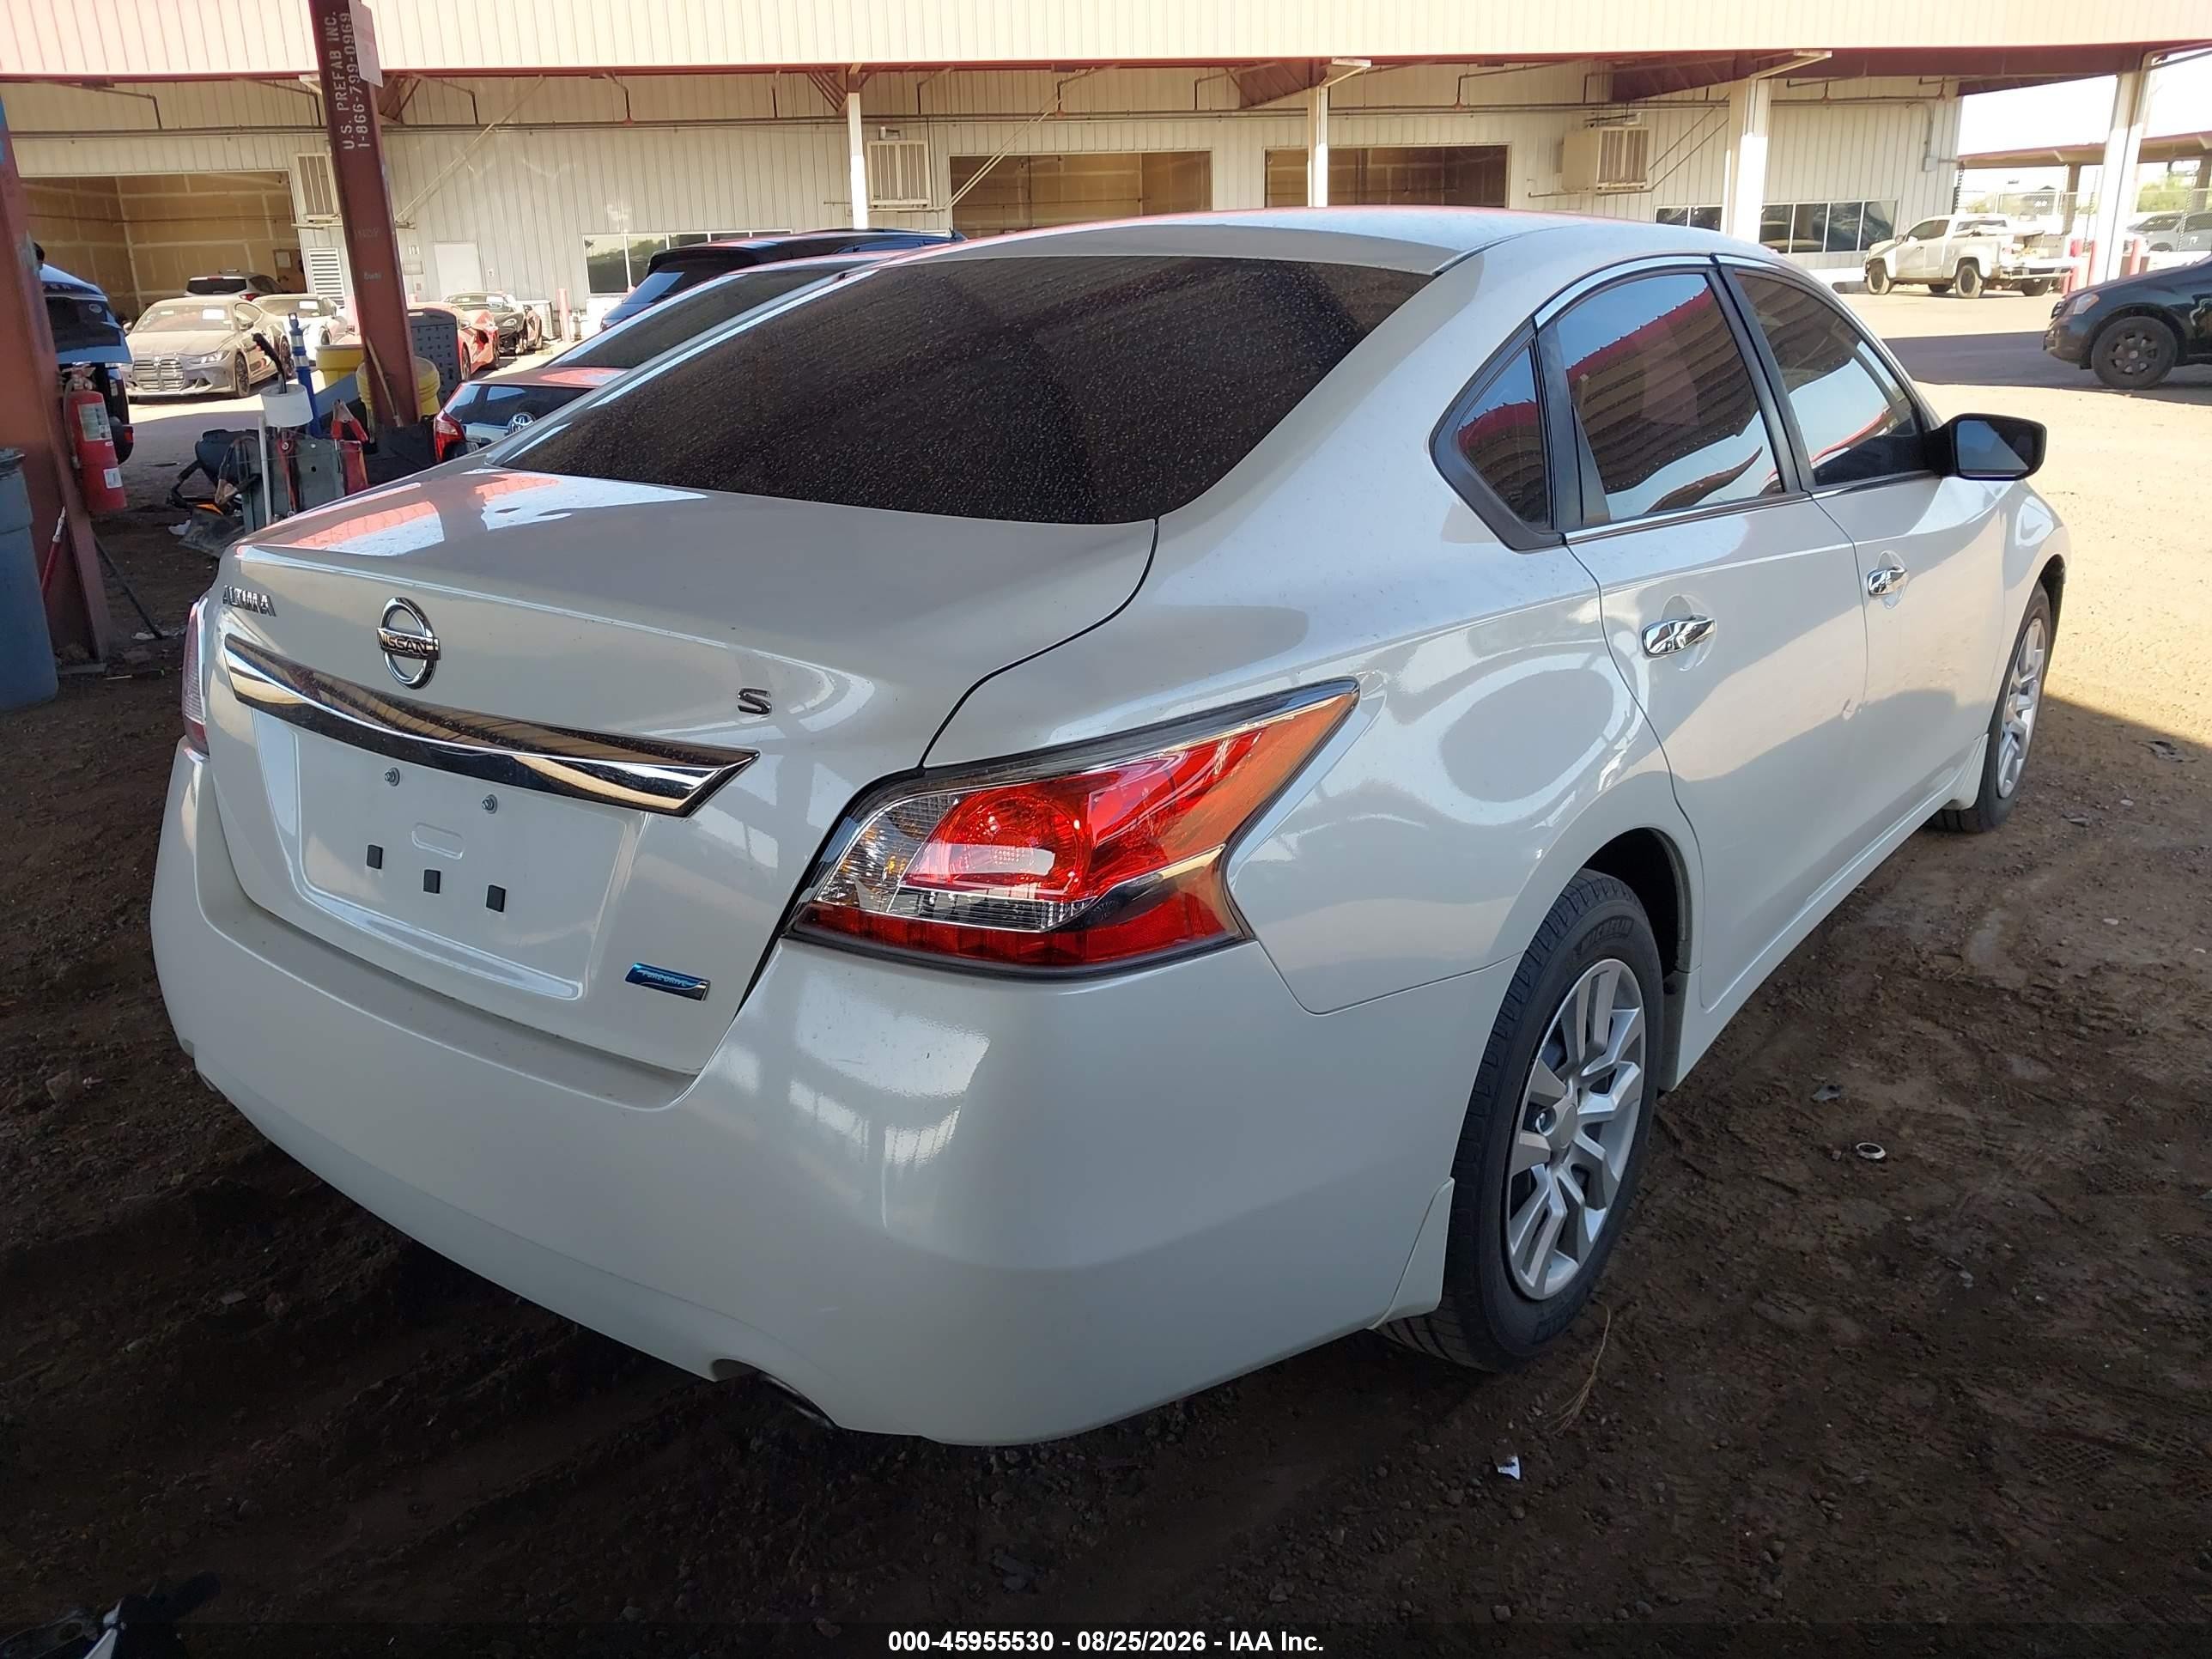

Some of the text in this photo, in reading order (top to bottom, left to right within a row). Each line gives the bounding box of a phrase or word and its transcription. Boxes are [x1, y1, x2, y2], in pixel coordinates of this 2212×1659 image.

[324, 10, 356, 150] U.S. PREFAB INC.
[222, 585, 276, 617] ALTIMA
[378, 630, 429, 657] NISSAN
[737, 687, 772, 716] S
